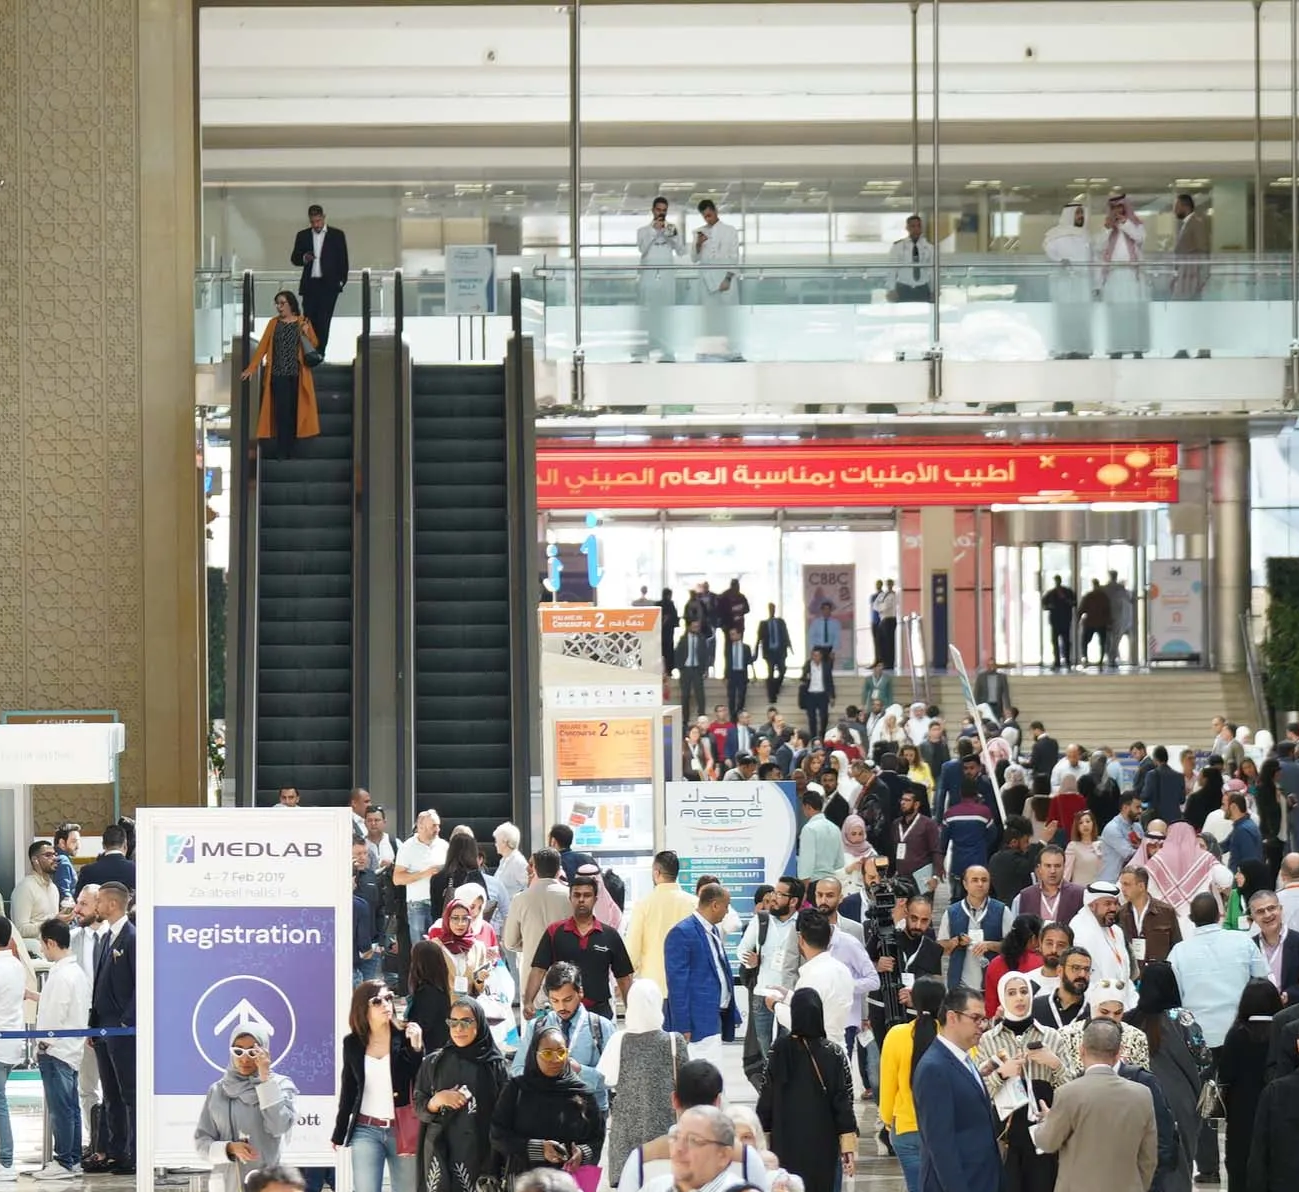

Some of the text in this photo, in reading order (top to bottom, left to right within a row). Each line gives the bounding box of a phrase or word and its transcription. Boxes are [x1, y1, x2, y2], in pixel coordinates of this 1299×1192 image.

[564, 466, 655, 494] الصيني
[660, 465, 728, 490] العام
[732, 464, 836, 490] بمناسبة
[840, 462, 940, 489] الأمنيات
[944, 459, 1016, 488] أطيب
[595, 612, 605, 628] 2
[599, 722, 609, 737] 2
[679, 808, 763, 818] AEEDC
[201, 842, 323, 858] MEDLAB
[203, 871, 286, 882] 4 7 Feb 2019
[167, 923, 321, 949] Registration
